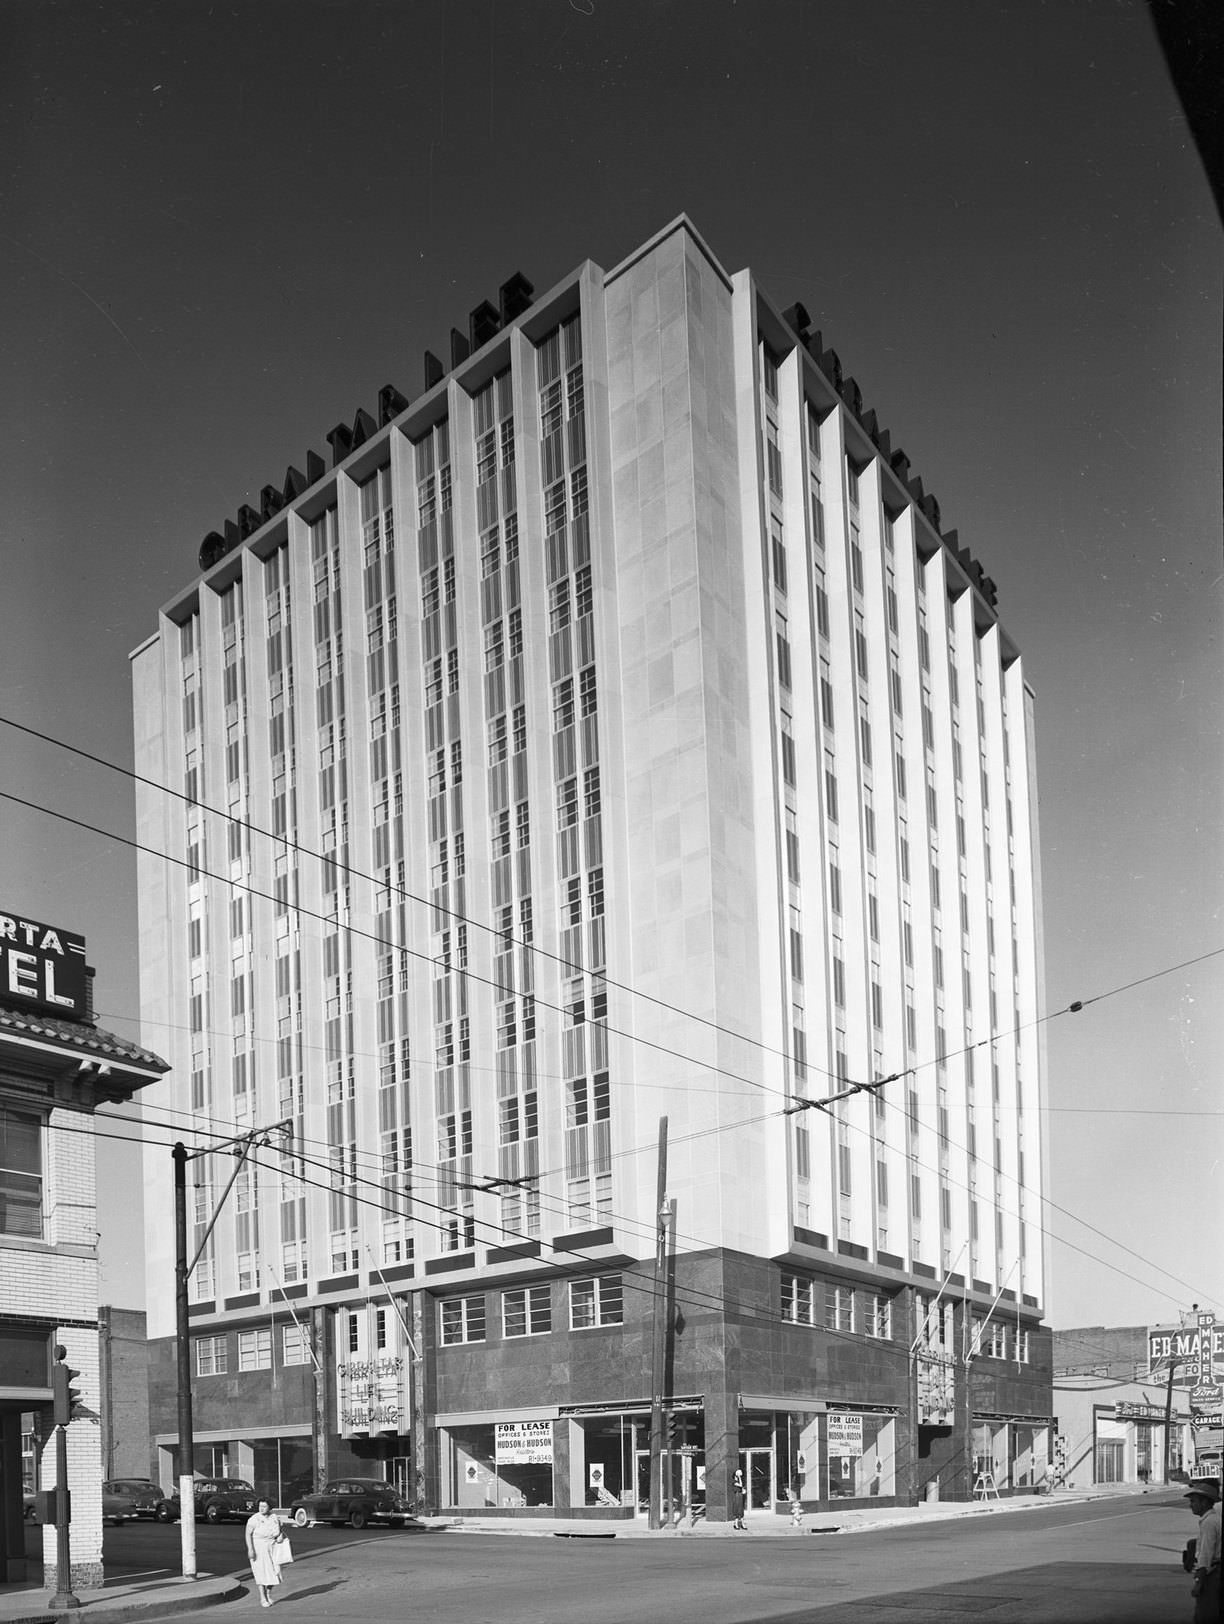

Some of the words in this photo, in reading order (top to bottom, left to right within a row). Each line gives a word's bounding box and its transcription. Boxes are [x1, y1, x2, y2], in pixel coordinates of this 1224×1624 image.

[0, 914, 65, 956] RTA
[0, 946, 75, 1008] EL
[1199, 1316, 1213, 1325] ED
[1151, 1336, 1171, 1358] ED
[1176, 1333, 1224, 1357] MAE
[1201, 1328, 1211, 1384] MAHER
[337, 1357, 403, 1378] GIBRALTAR
[1185, 1364, 1199, 1375] FO
[356, 1383, 382, 1399] LIFE
[1193, 1386, 1220, 1397] Ford
[341, 1404, 398, 1422] BUILDING
[1194, 1416, 1221, 1425] GARAGE
[498, 1424, 515, 1432] FOR
[521, 1422, 550, 1430] LEASE
[497, 1440, 521, 1448] HUDSON
[526, 1438, 551, 1447] HUDSON
